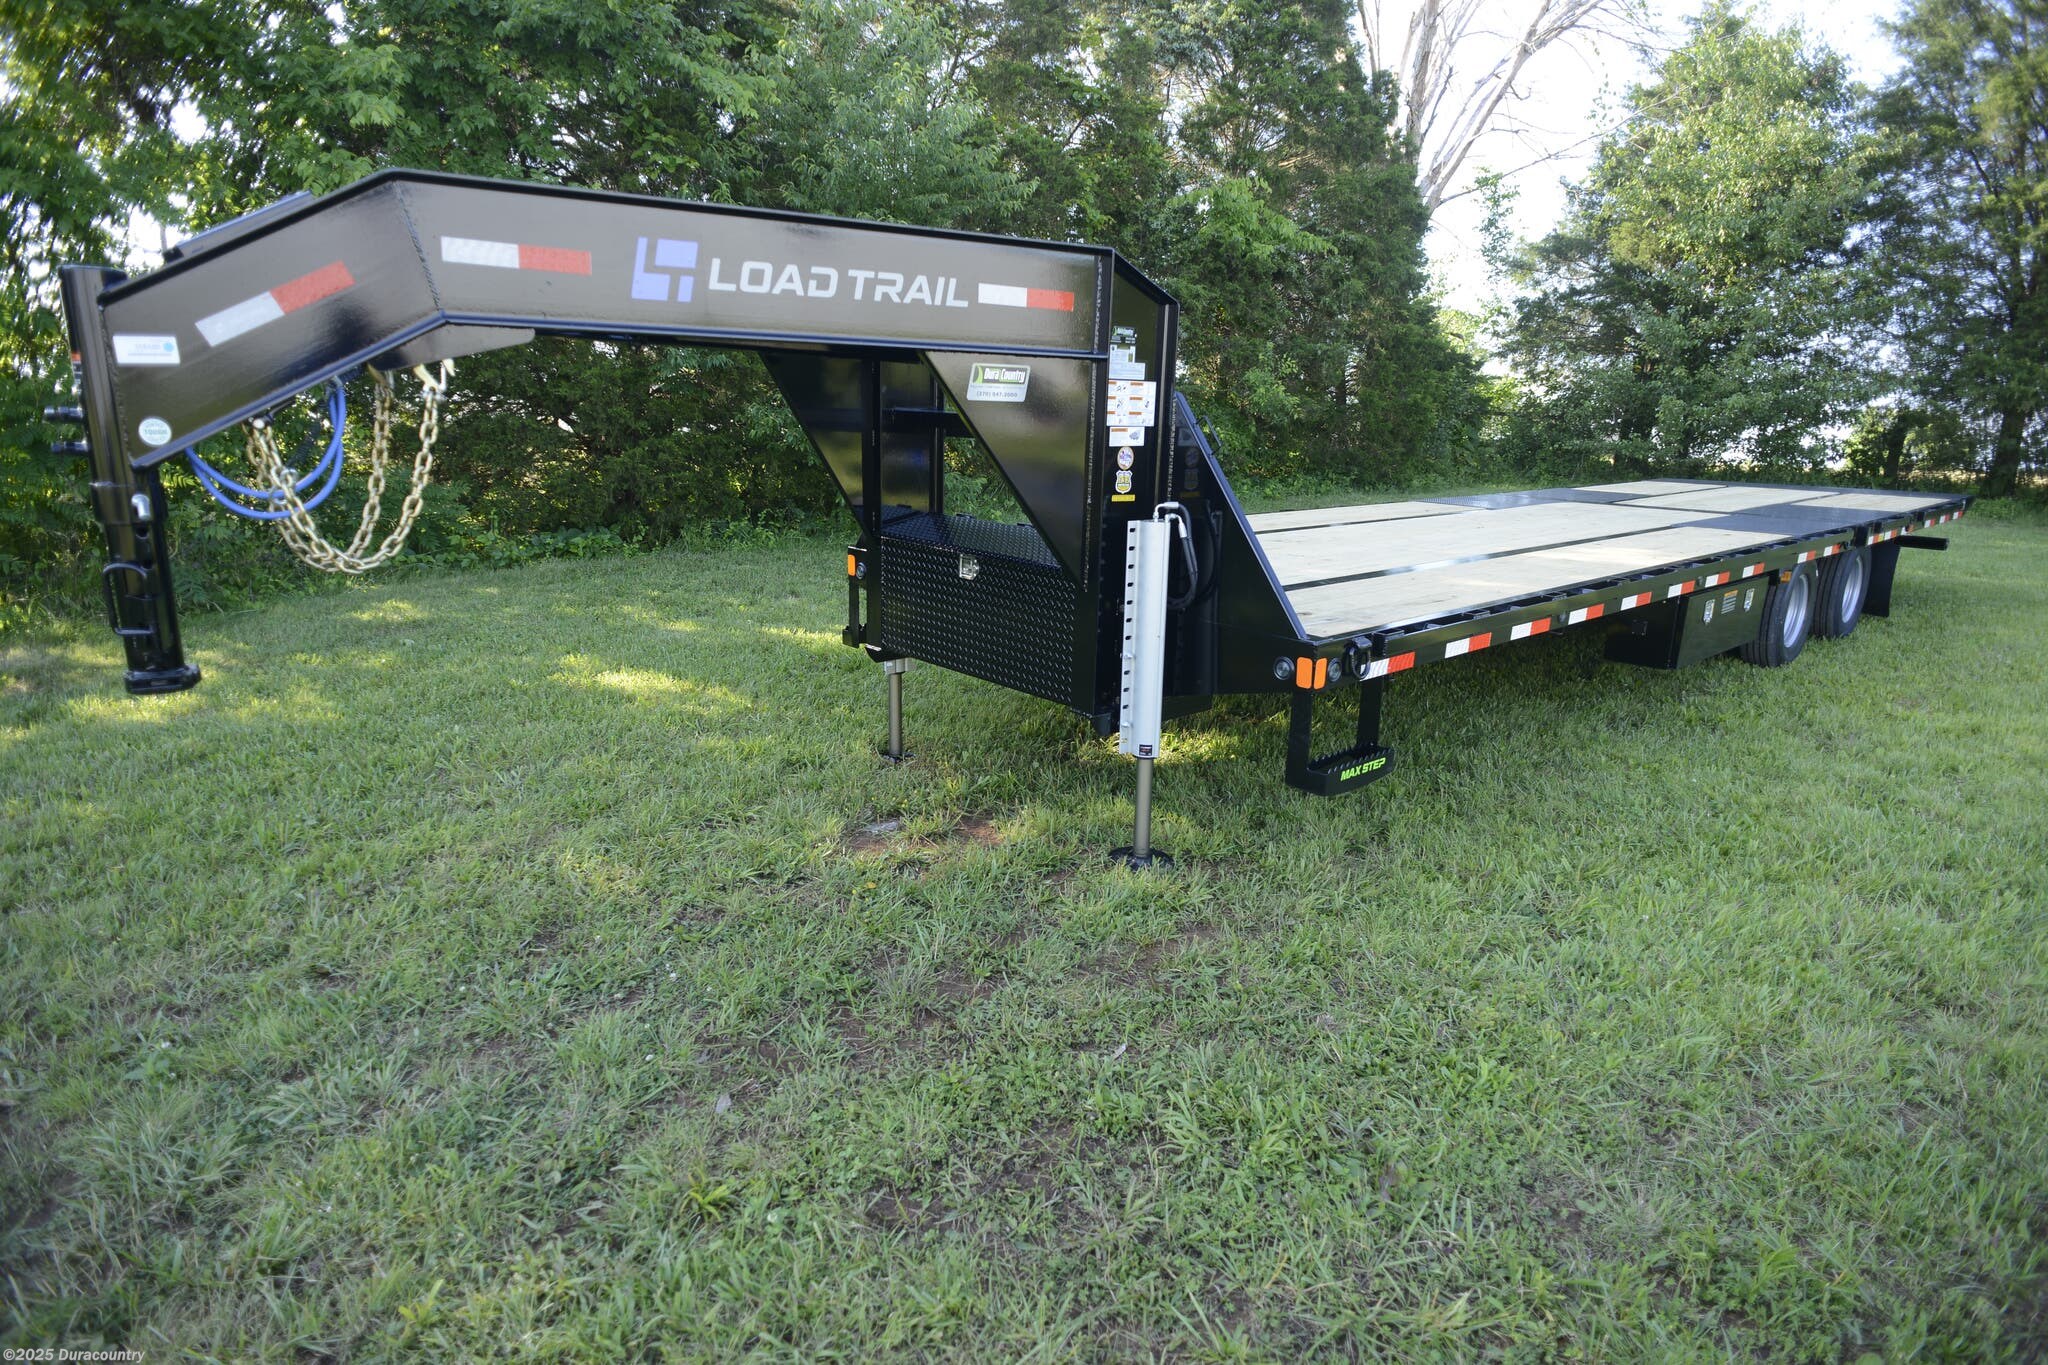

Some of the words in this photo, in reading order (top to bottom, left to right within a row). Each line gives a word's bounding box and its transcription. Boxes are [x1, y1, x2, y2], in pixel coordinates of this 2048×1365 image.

[708, 257, 839, 298] LOAD
[848, 268, 969, 308] TRAIL
[984, 367, 1000, 380] Dura
[1001, 368, 1025, 383] Country
[1340, 765, 1362, 781] MAX
[1362, 757, 1386, 774] STEP
